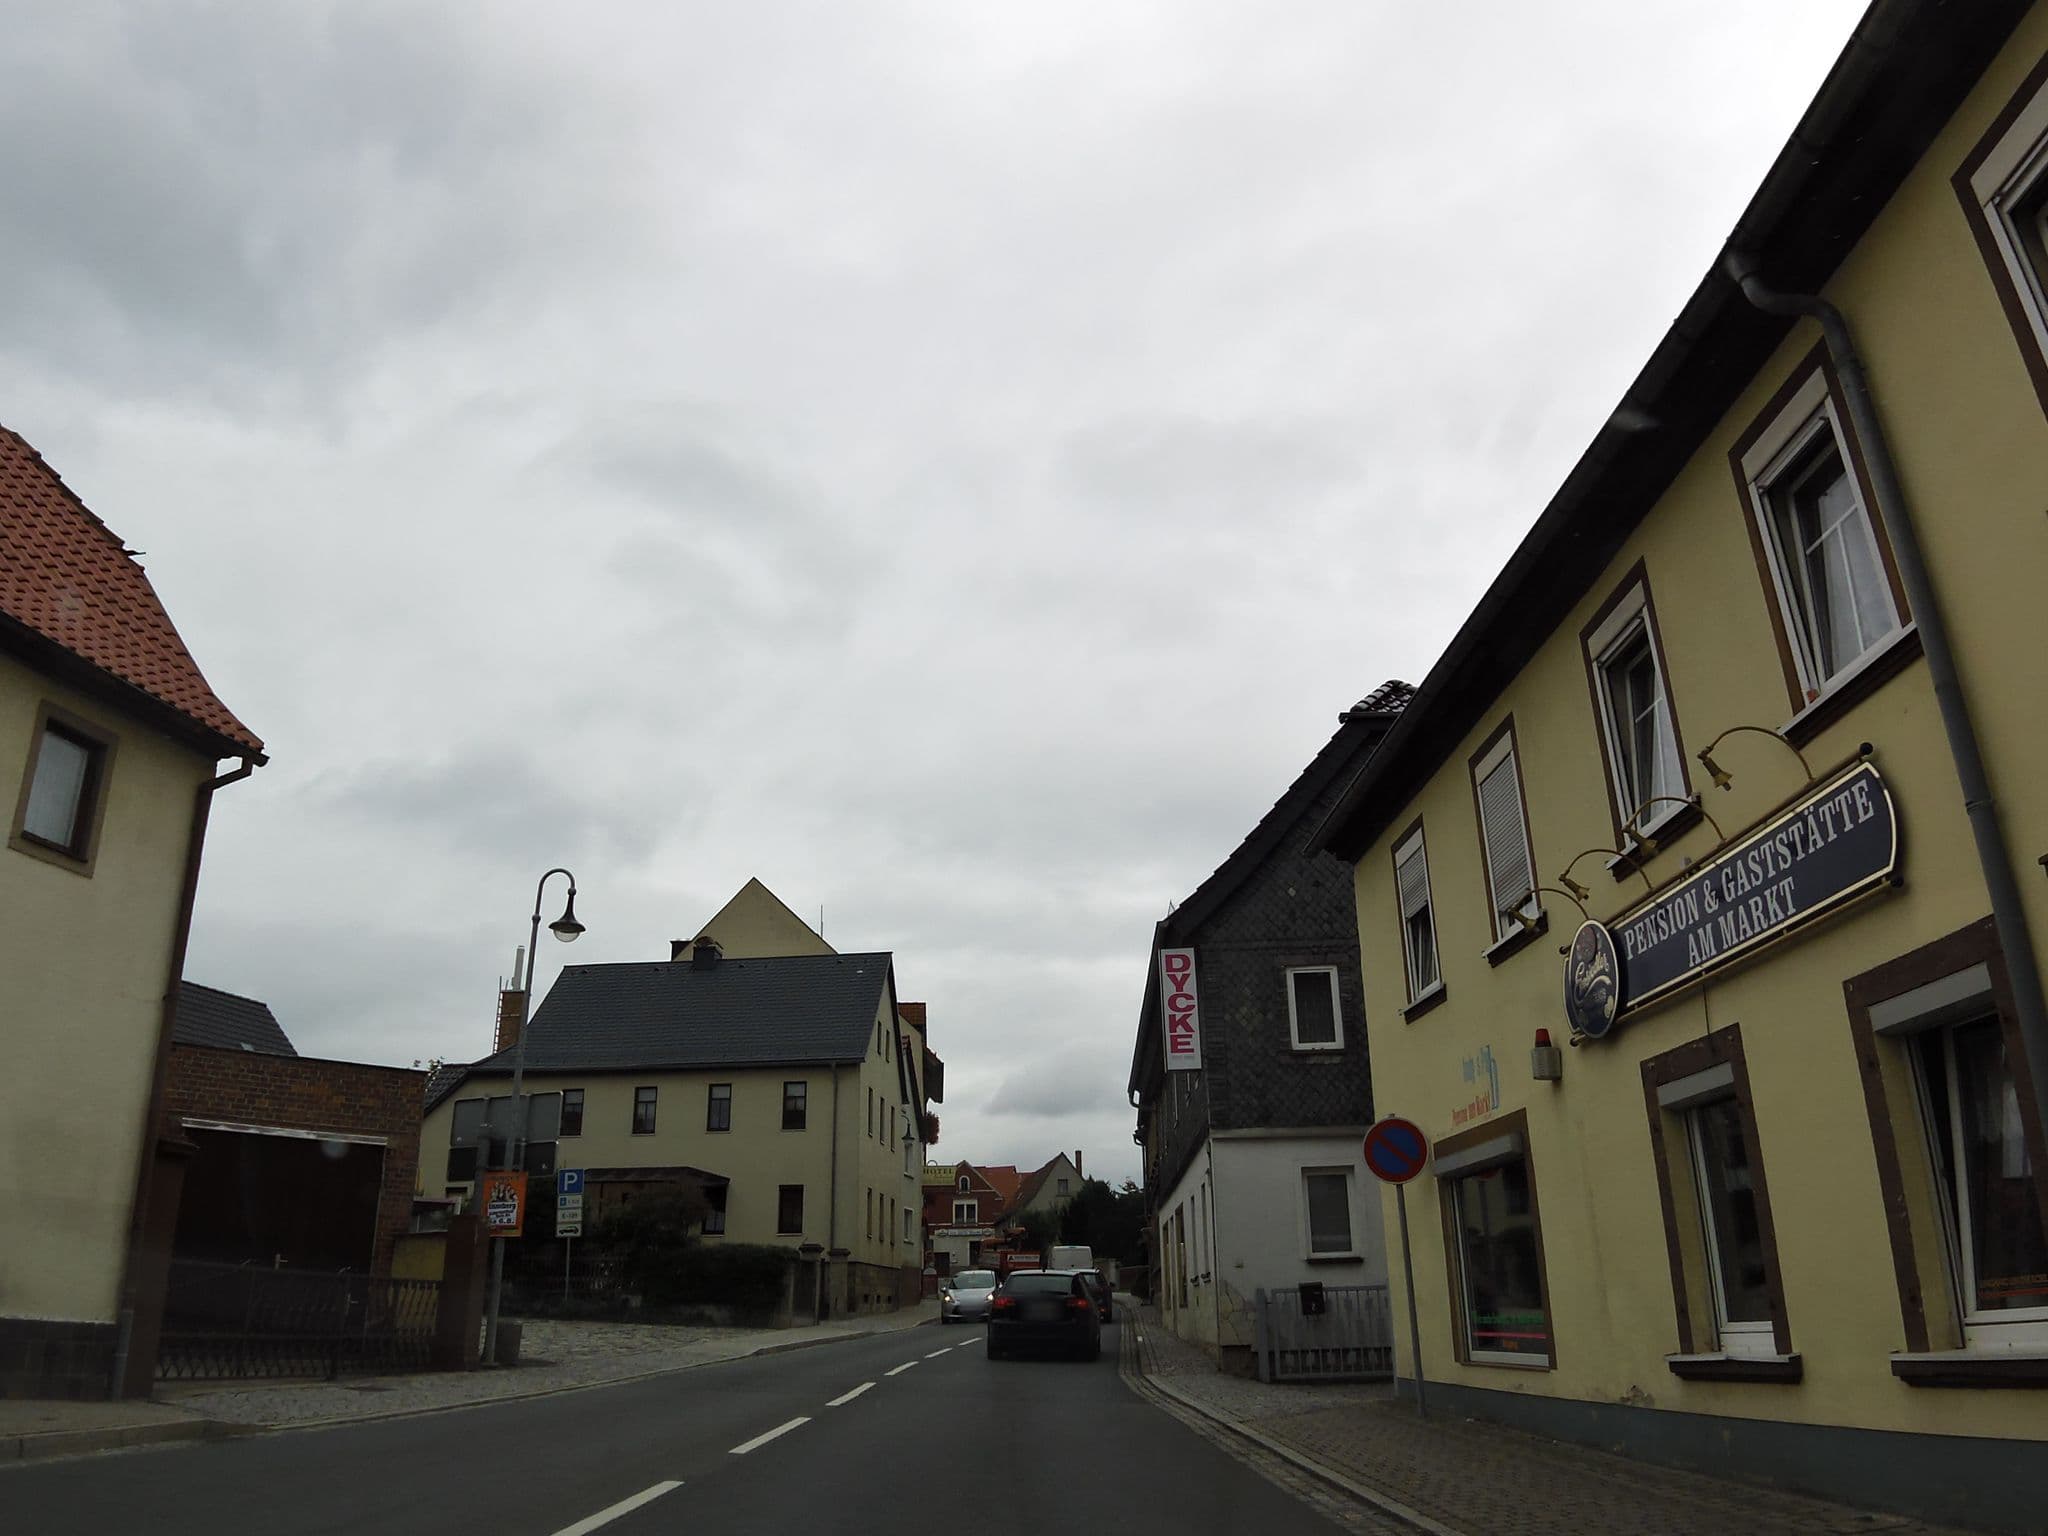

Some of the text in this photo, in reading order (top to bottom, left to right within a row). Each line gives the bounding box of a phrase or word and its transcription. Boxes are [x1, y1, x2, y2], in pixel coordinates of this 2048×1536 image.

[1624, 779, 1875, 961] PENSION & GASTSTÄTTE
[1688, 877, 1798, 968] AM MARKT
[1165, 954, 1196, 1054] DYCKE
[564, 1172, 578, 1191] P
